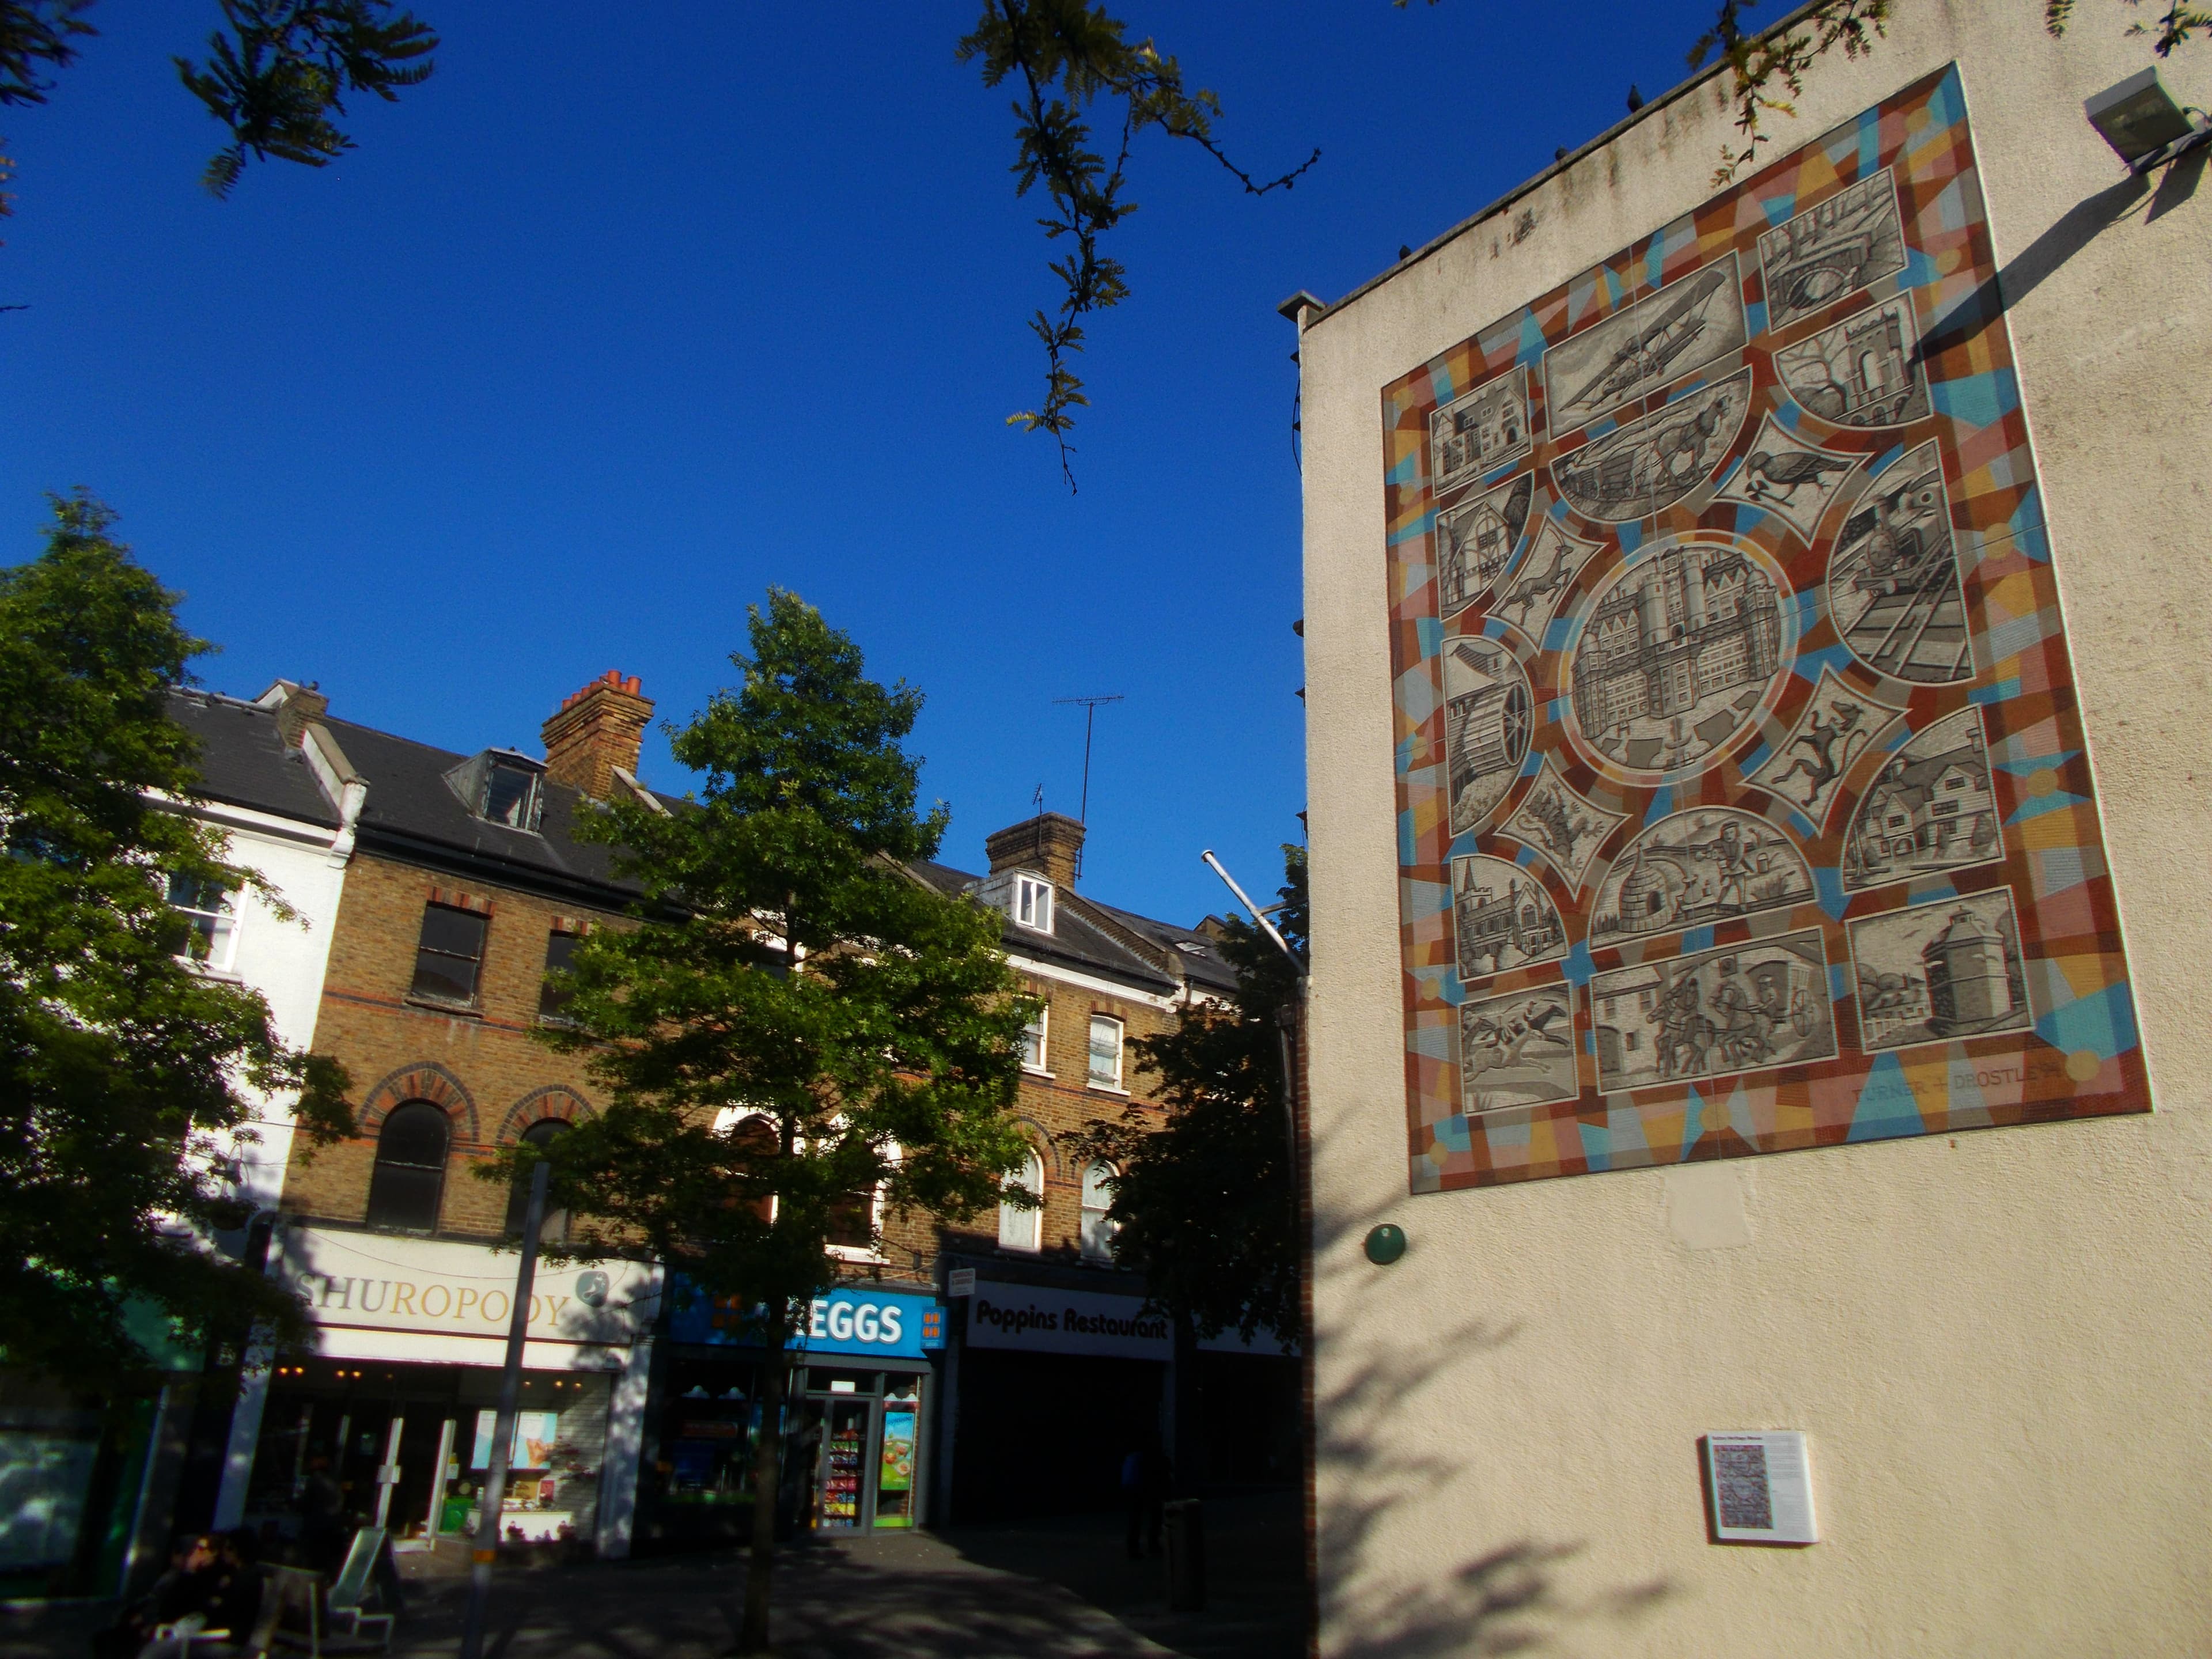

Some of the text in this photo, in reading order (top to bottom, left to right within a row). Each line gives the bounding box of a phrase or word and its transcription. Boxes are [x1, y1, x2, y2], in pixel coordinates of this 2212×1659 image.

[753, 1296, 903, 1344] EGGS
[976, 1300, 1168, 1339] Poppins Restaurant
